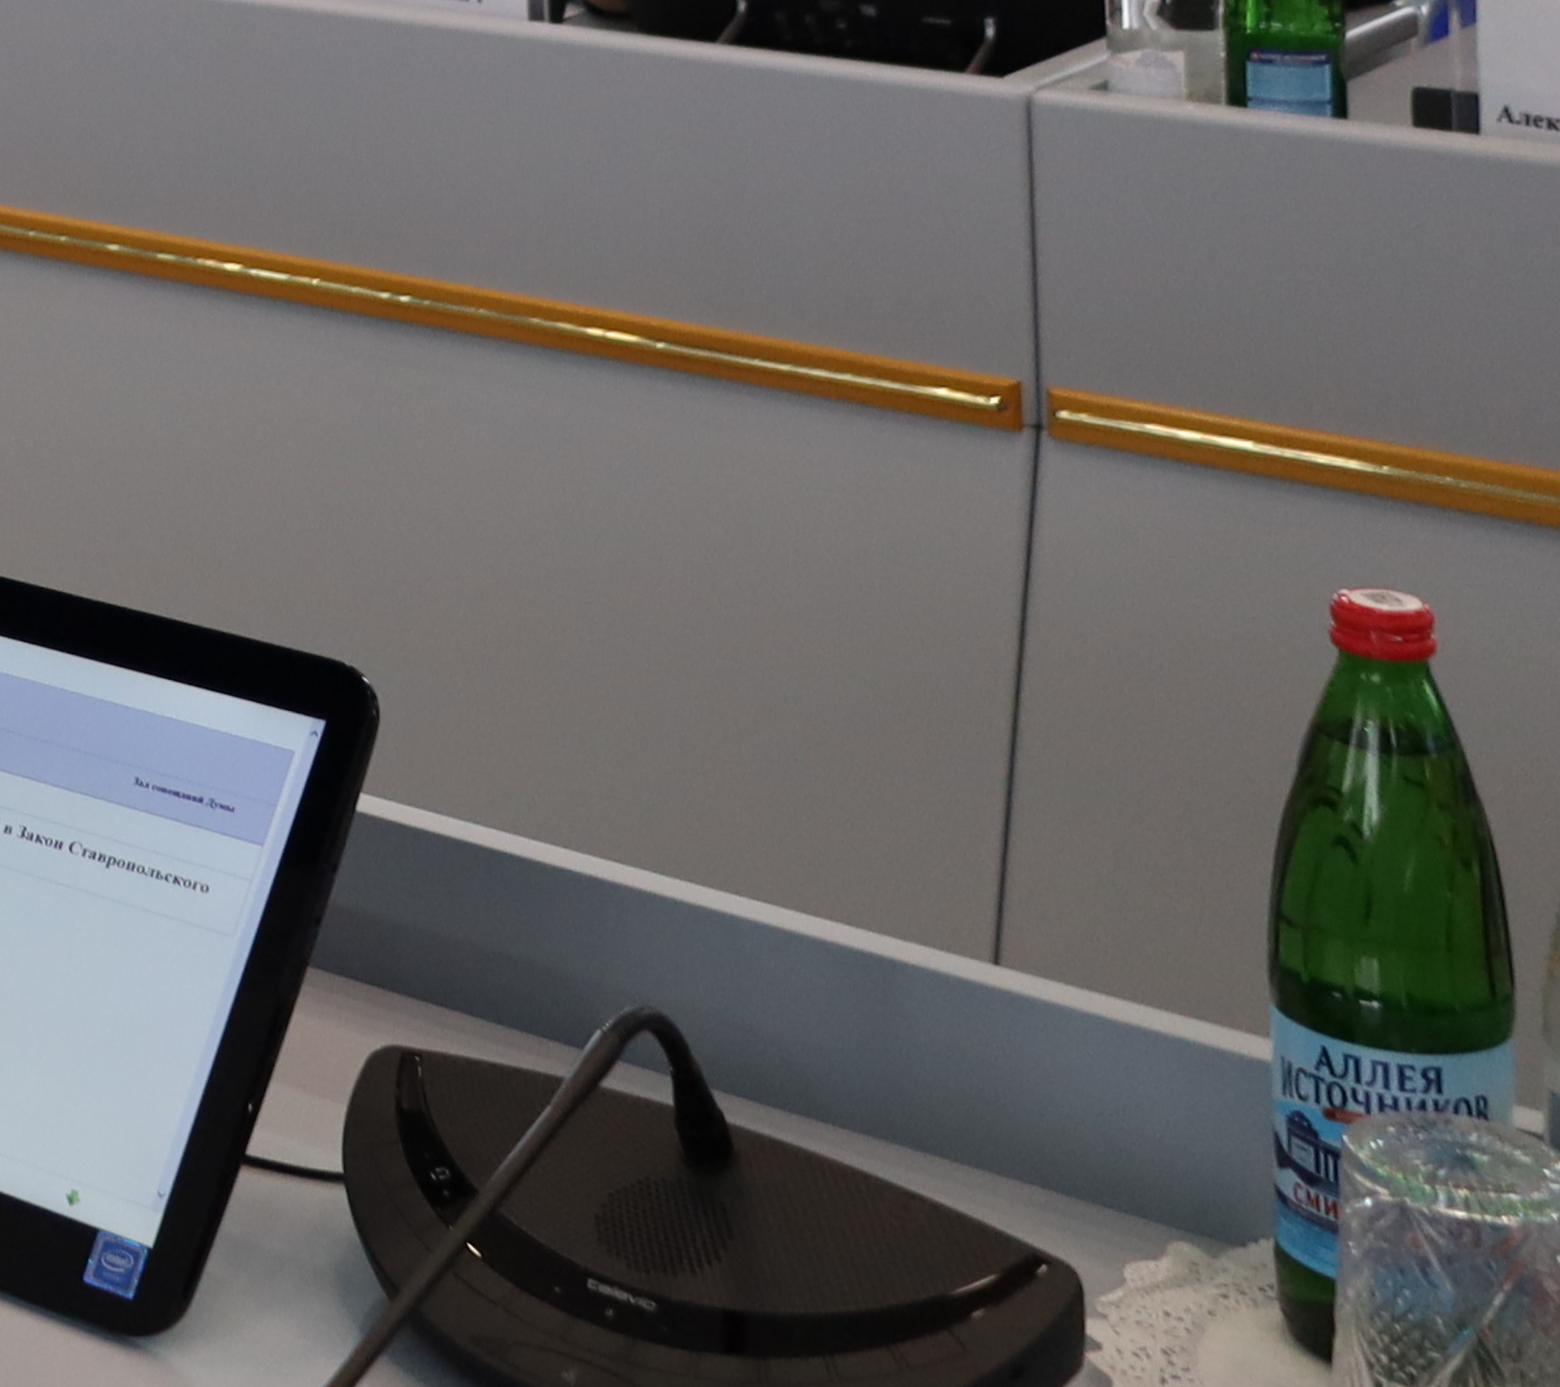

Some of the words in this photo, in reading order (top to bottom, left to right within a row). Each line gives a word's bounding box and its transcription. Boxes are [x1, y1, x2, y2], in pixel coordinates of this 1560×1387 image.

[3, 824, 14, 836] в
[19, 825, 64, 851] Закон
[68, 840, 211, 895] Ставропольского
[1314, 1044, 1444, 1096] АЛЛЕЯ
